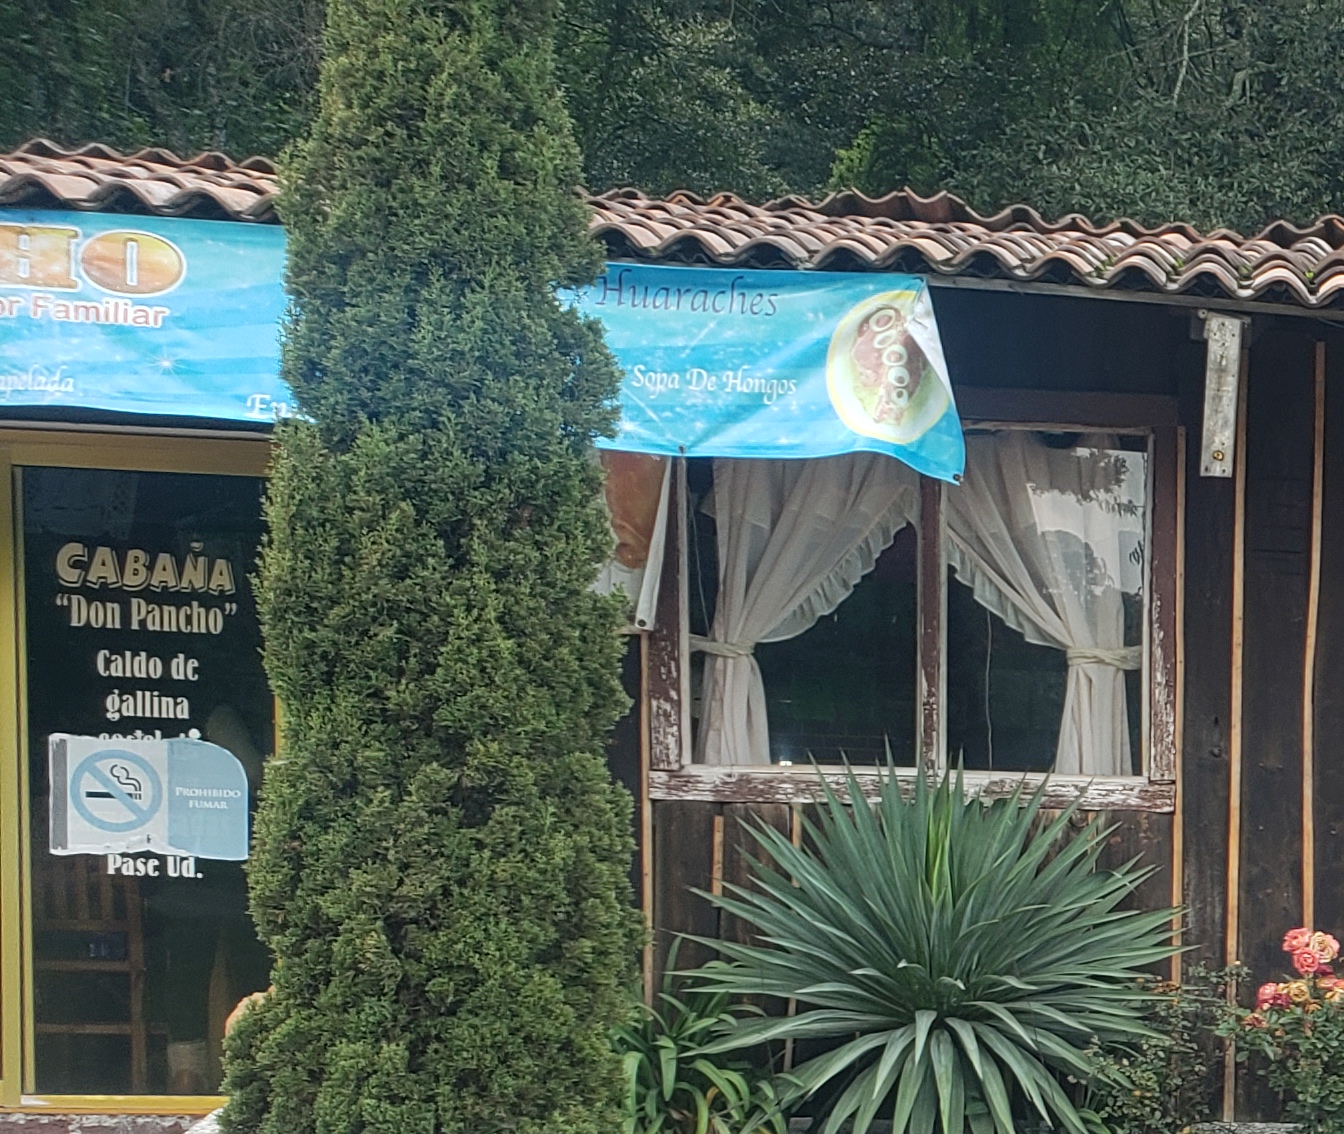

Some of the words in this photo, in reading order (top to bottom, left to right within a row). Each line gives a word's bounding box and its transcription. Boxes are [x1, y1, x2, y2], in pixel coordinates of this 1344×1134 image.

[595, 268, 780, 317] Huaraches
[31, 293, 169, 328] Familiar
[632, 364, 680, 398] Sopa
[685, 368, 717, 391] De
[722, 365, 798, 405] Hongos
[55, 541, 236, 595] CABAÑA
[97, 649, 163, 679] Caldo
[171, 653, 200, 681] de
[106, 689, 190, 721] gallina
[175, 786, 242, 799] PROHIBIDO
[188, 799, 229, 810] FUMAR
[107, 853, 160, 877] Pase
[166, 855, 204, 879] Ud.
